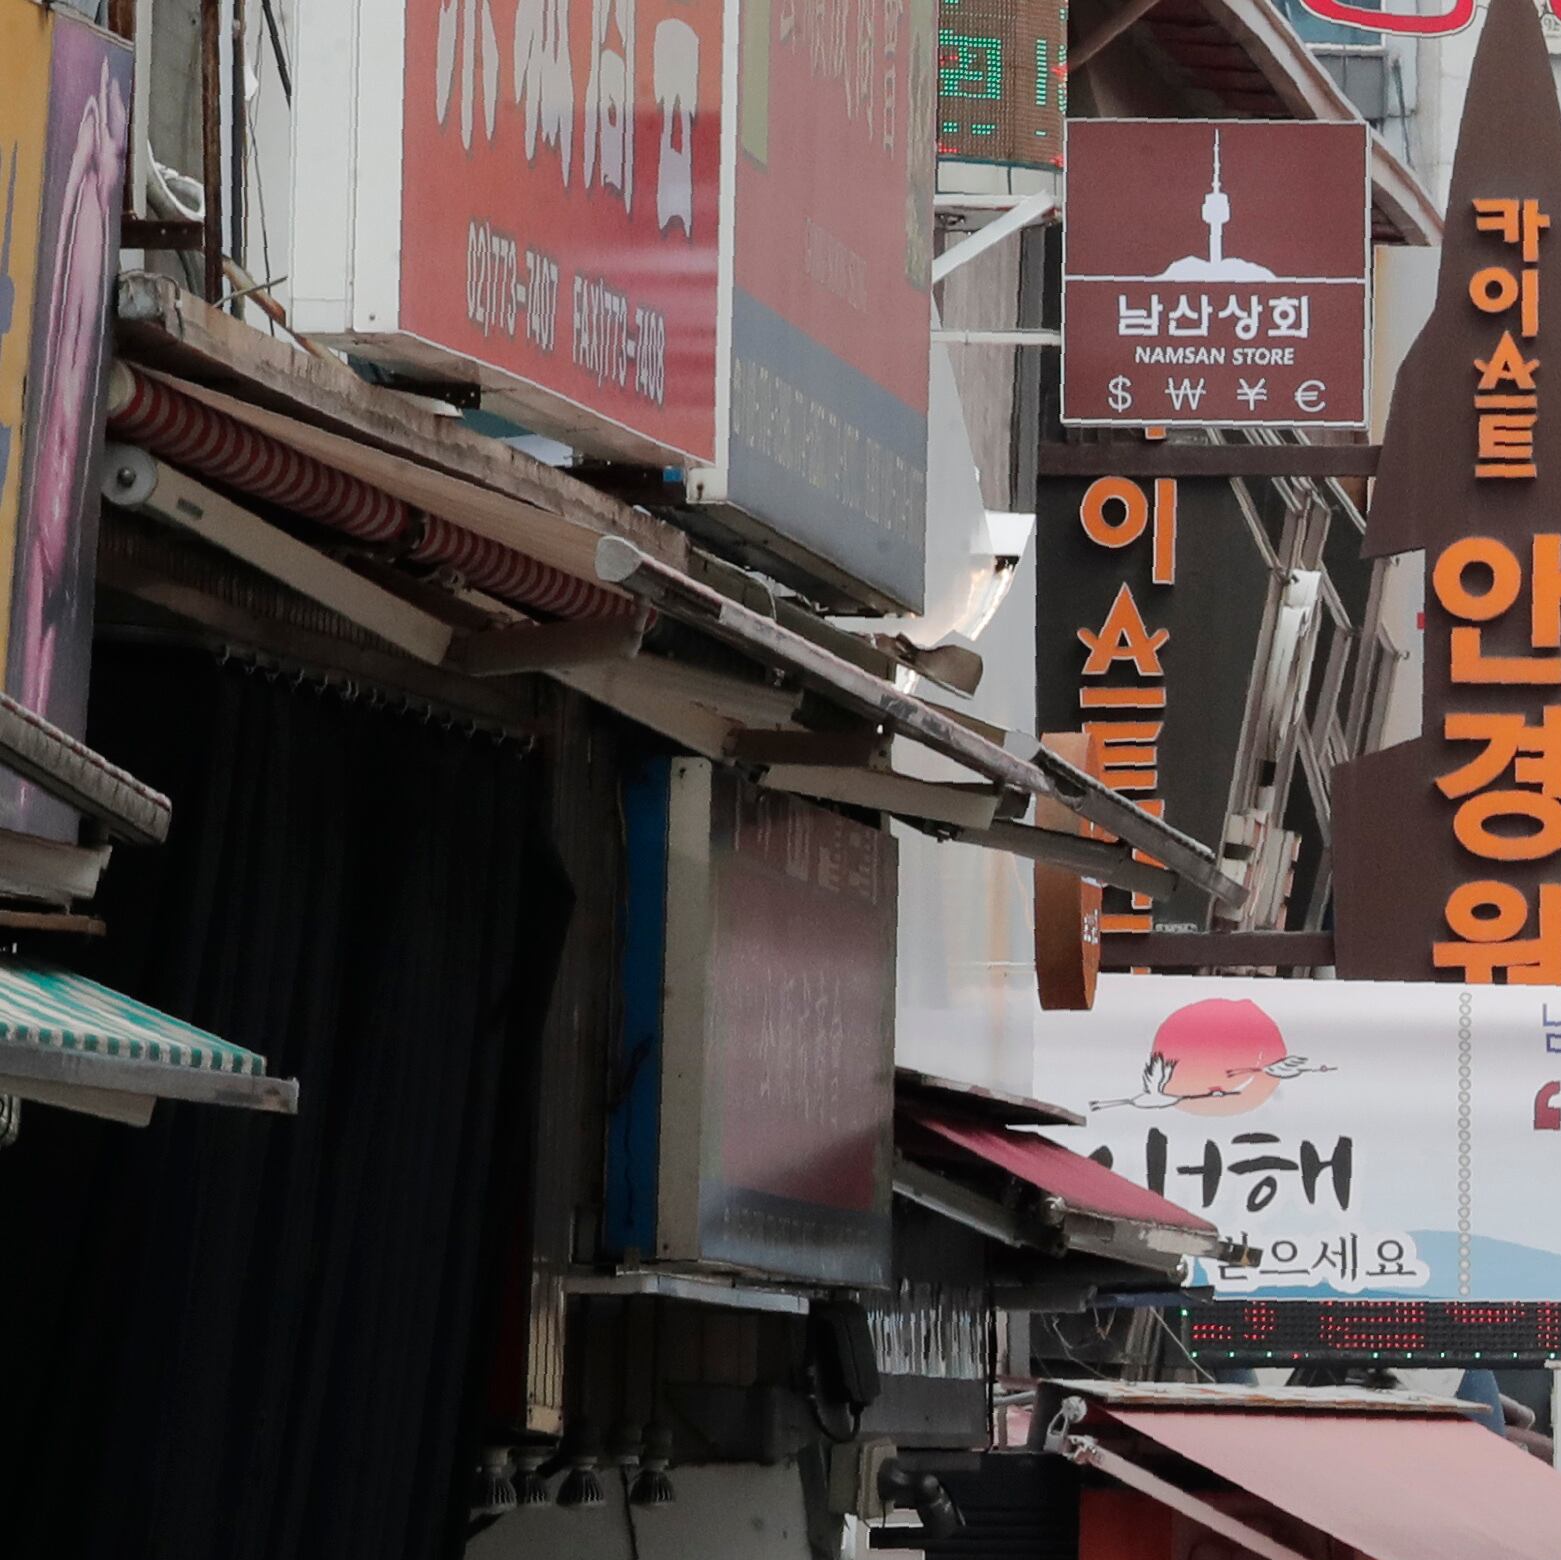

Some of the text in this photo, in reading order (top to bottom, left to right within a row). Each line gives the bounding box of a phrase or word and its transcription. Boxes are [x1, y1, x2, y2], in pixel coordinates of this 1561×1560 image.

[1116, 294, 1310, 342] 남산상회
[1468, 198, 1551, 479] 카이스트
[1135, 345, 1295, 366] NAMSAN STORE
